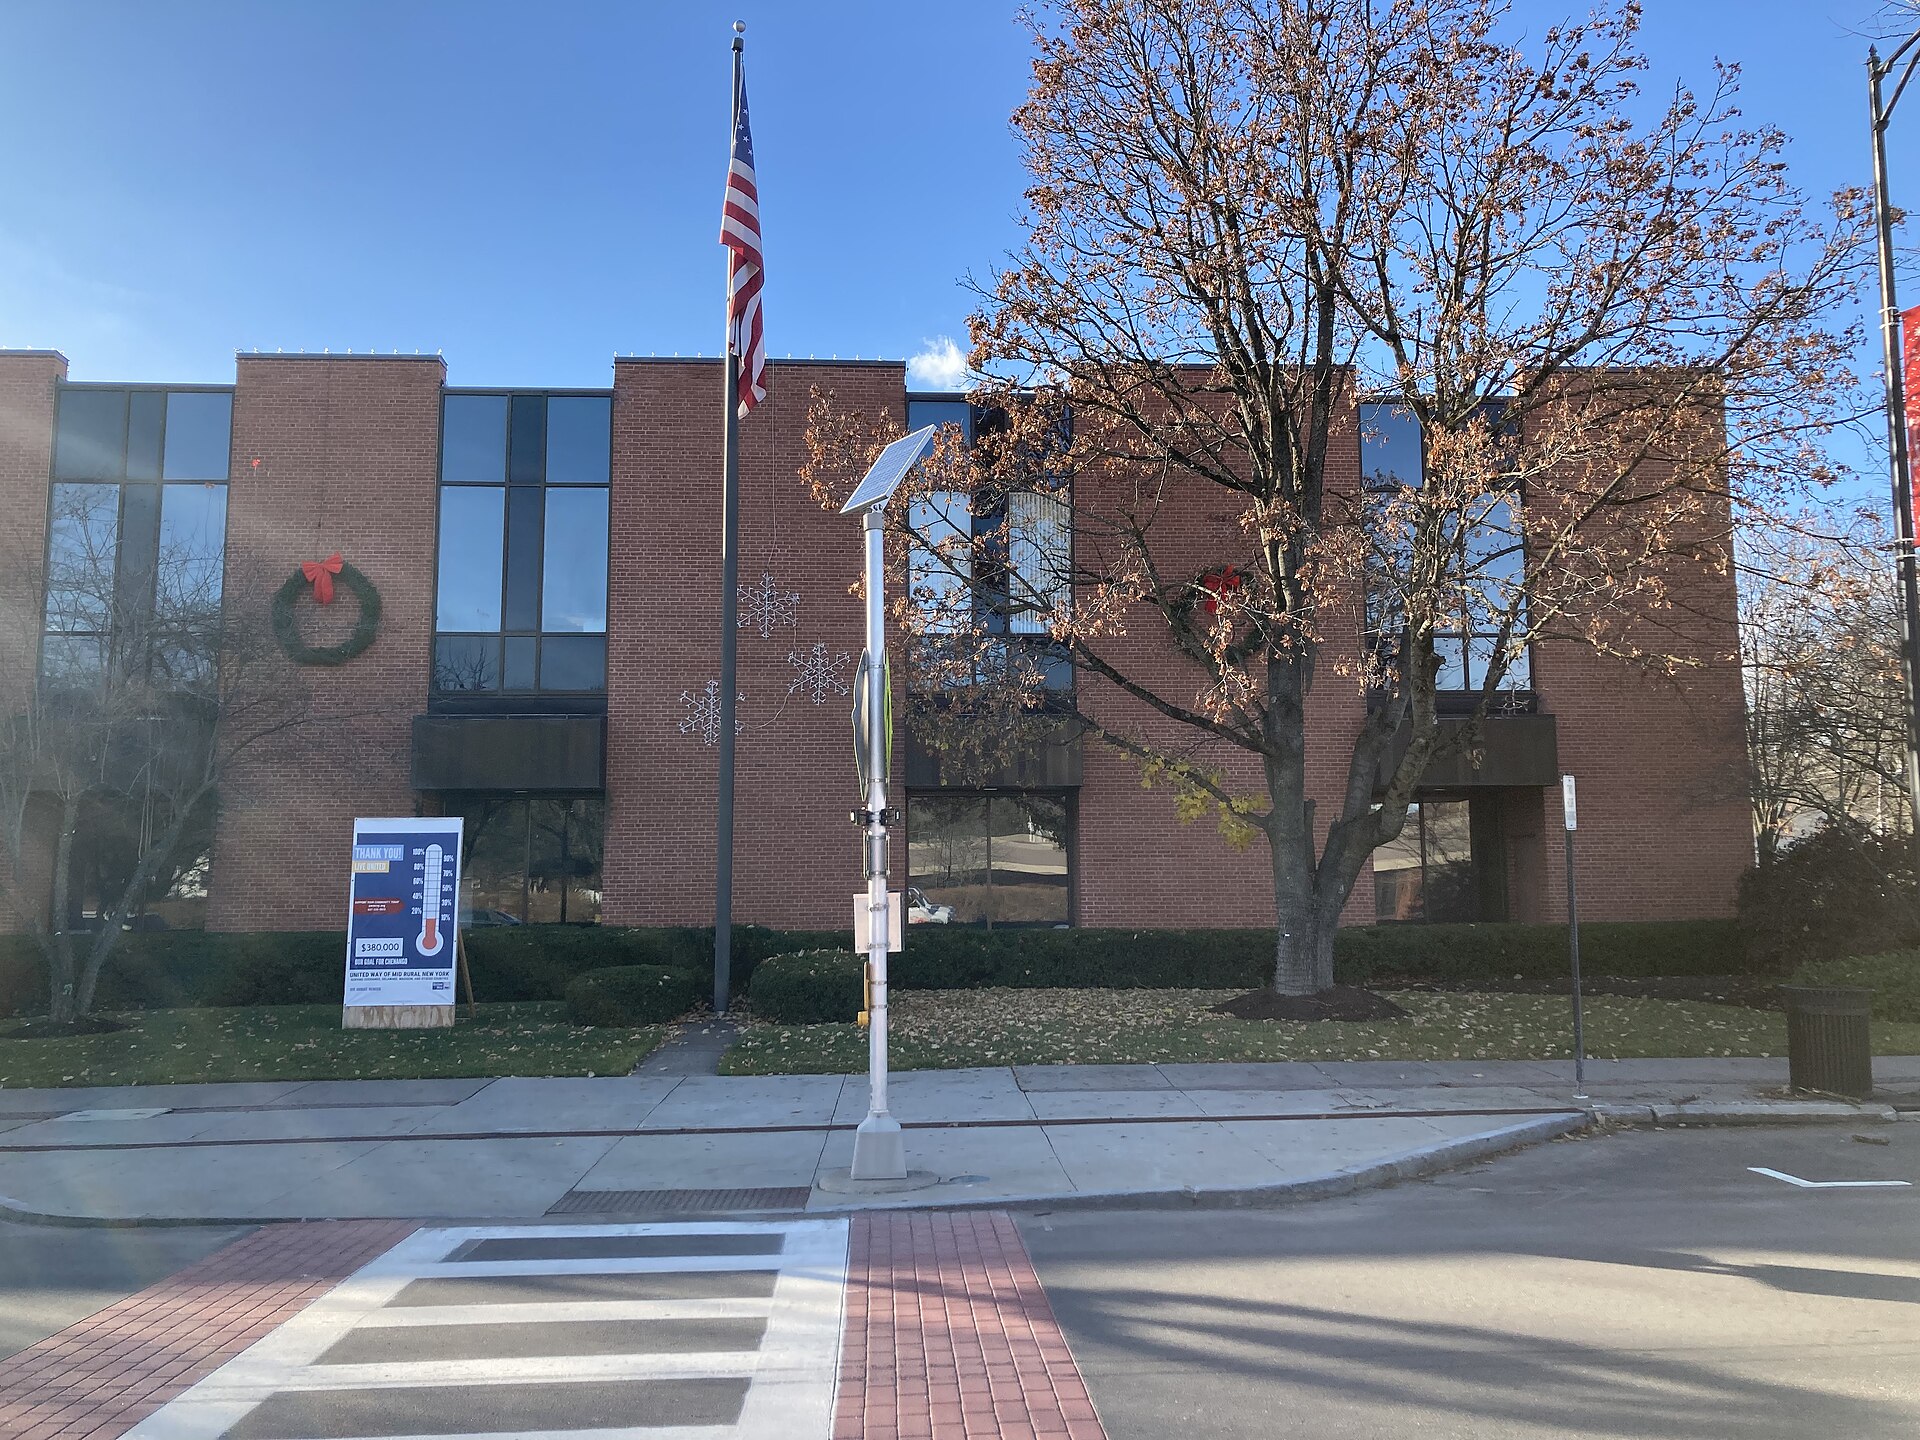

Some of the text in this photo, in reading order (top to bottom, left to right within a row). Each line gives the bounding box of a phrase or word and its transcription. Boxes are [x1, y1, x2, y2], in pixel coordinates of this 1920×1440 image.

[355, 847, 402, 859] THANK YOU!
[412, 848, 425, 856] 100%
[354, 862, 386, 871] LIVE UNITED
[442, 884, 452, 892] 50%
[412, 892, 423, 900] 40%
[441, 899, 452, 907] 30%
[411, 907, 422, 915] 20%
[441, 913, 450, 921] 10%
[354, 958, 363, 966] OUR
[364, 958, 375, 966] GOAL
[385, 957, 408, 965] CHENANGO
